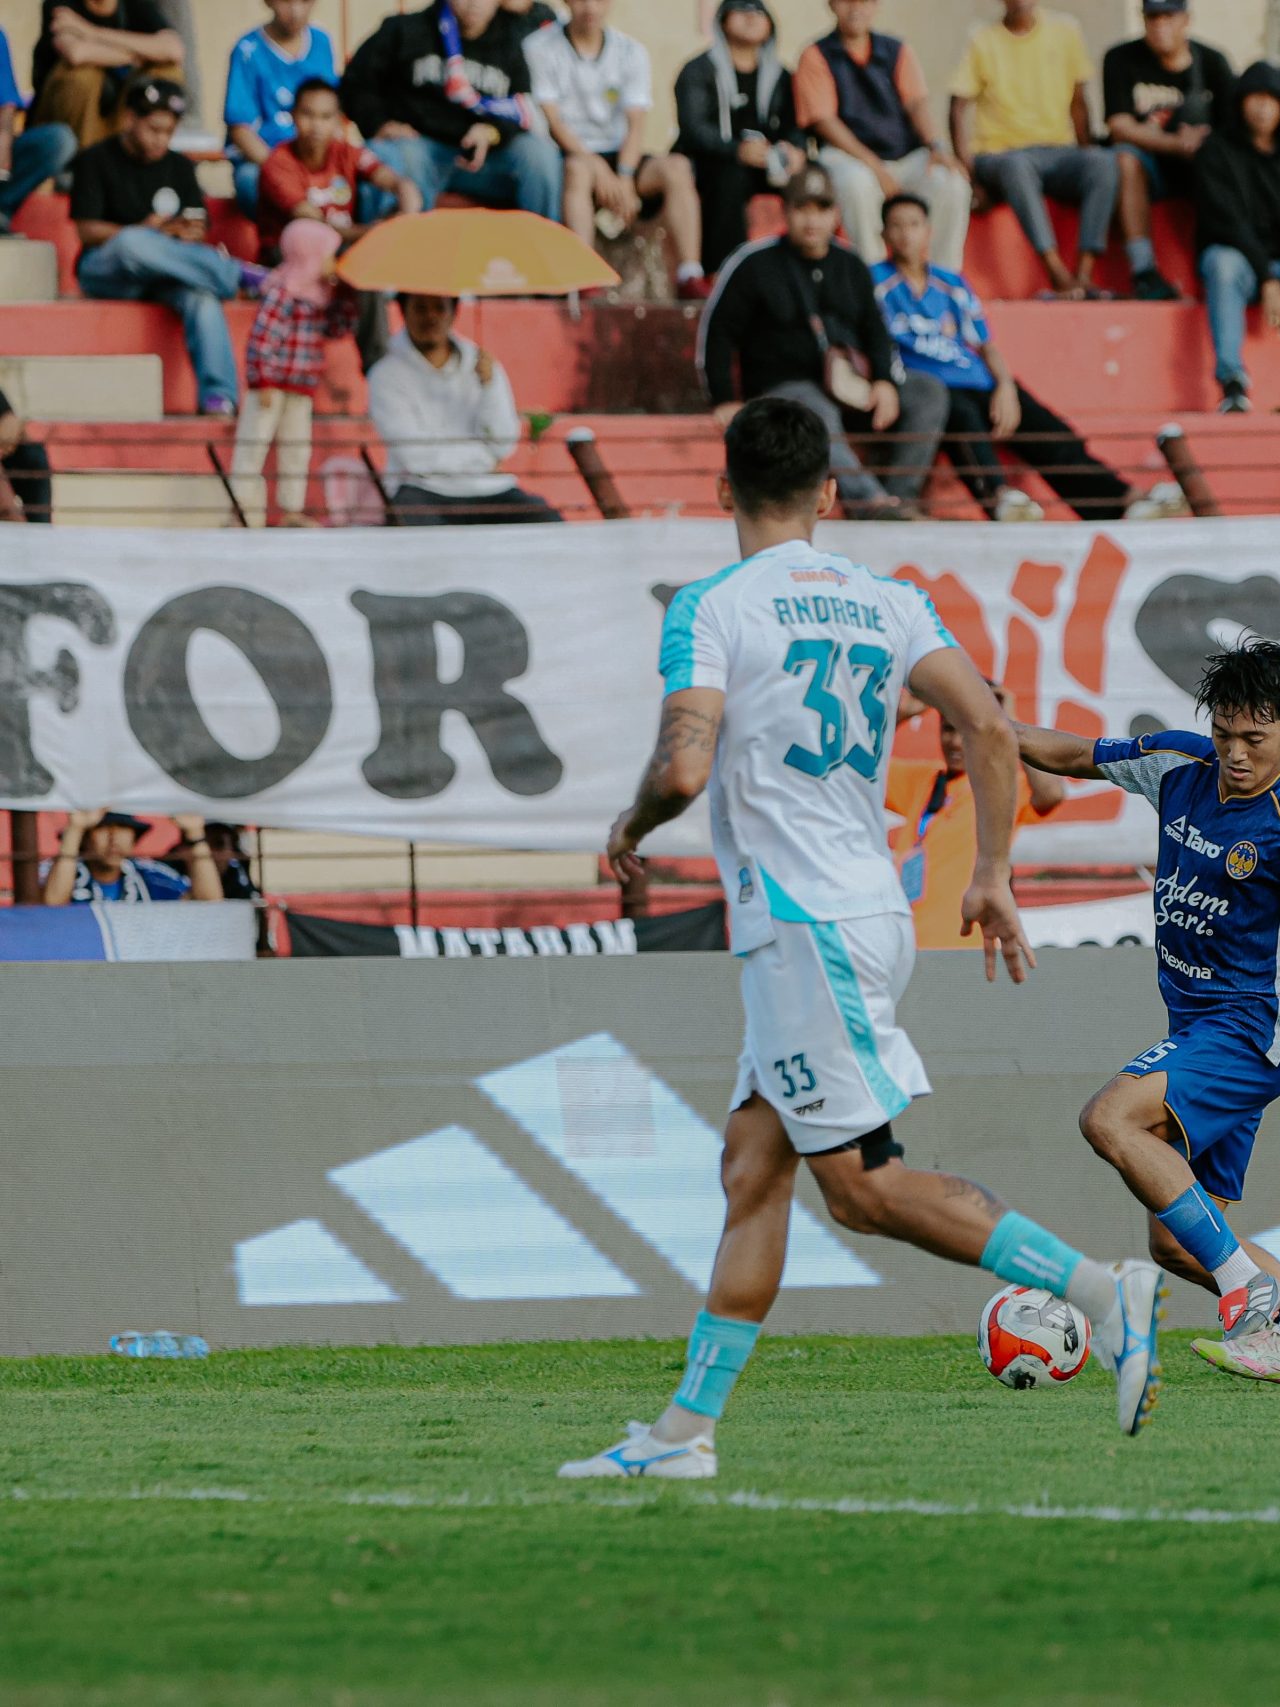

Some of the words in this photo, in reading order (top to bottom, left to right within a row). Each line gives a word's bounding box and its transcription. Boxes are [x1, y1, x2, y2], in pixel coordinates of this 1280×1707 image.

[0, 582, 562, 799] FOR
[783, 639, 893, 783] 33
[1164, 824, 1184, 845] apex
[1185, 825, 1222, 859] Taro
[1155, 866, 1229, 916] Adem
[1155, 895, 1206, 935] Sari
[1161, 945, 1212, 980] Rexona
[774, 1053, 816, 1098] 33
